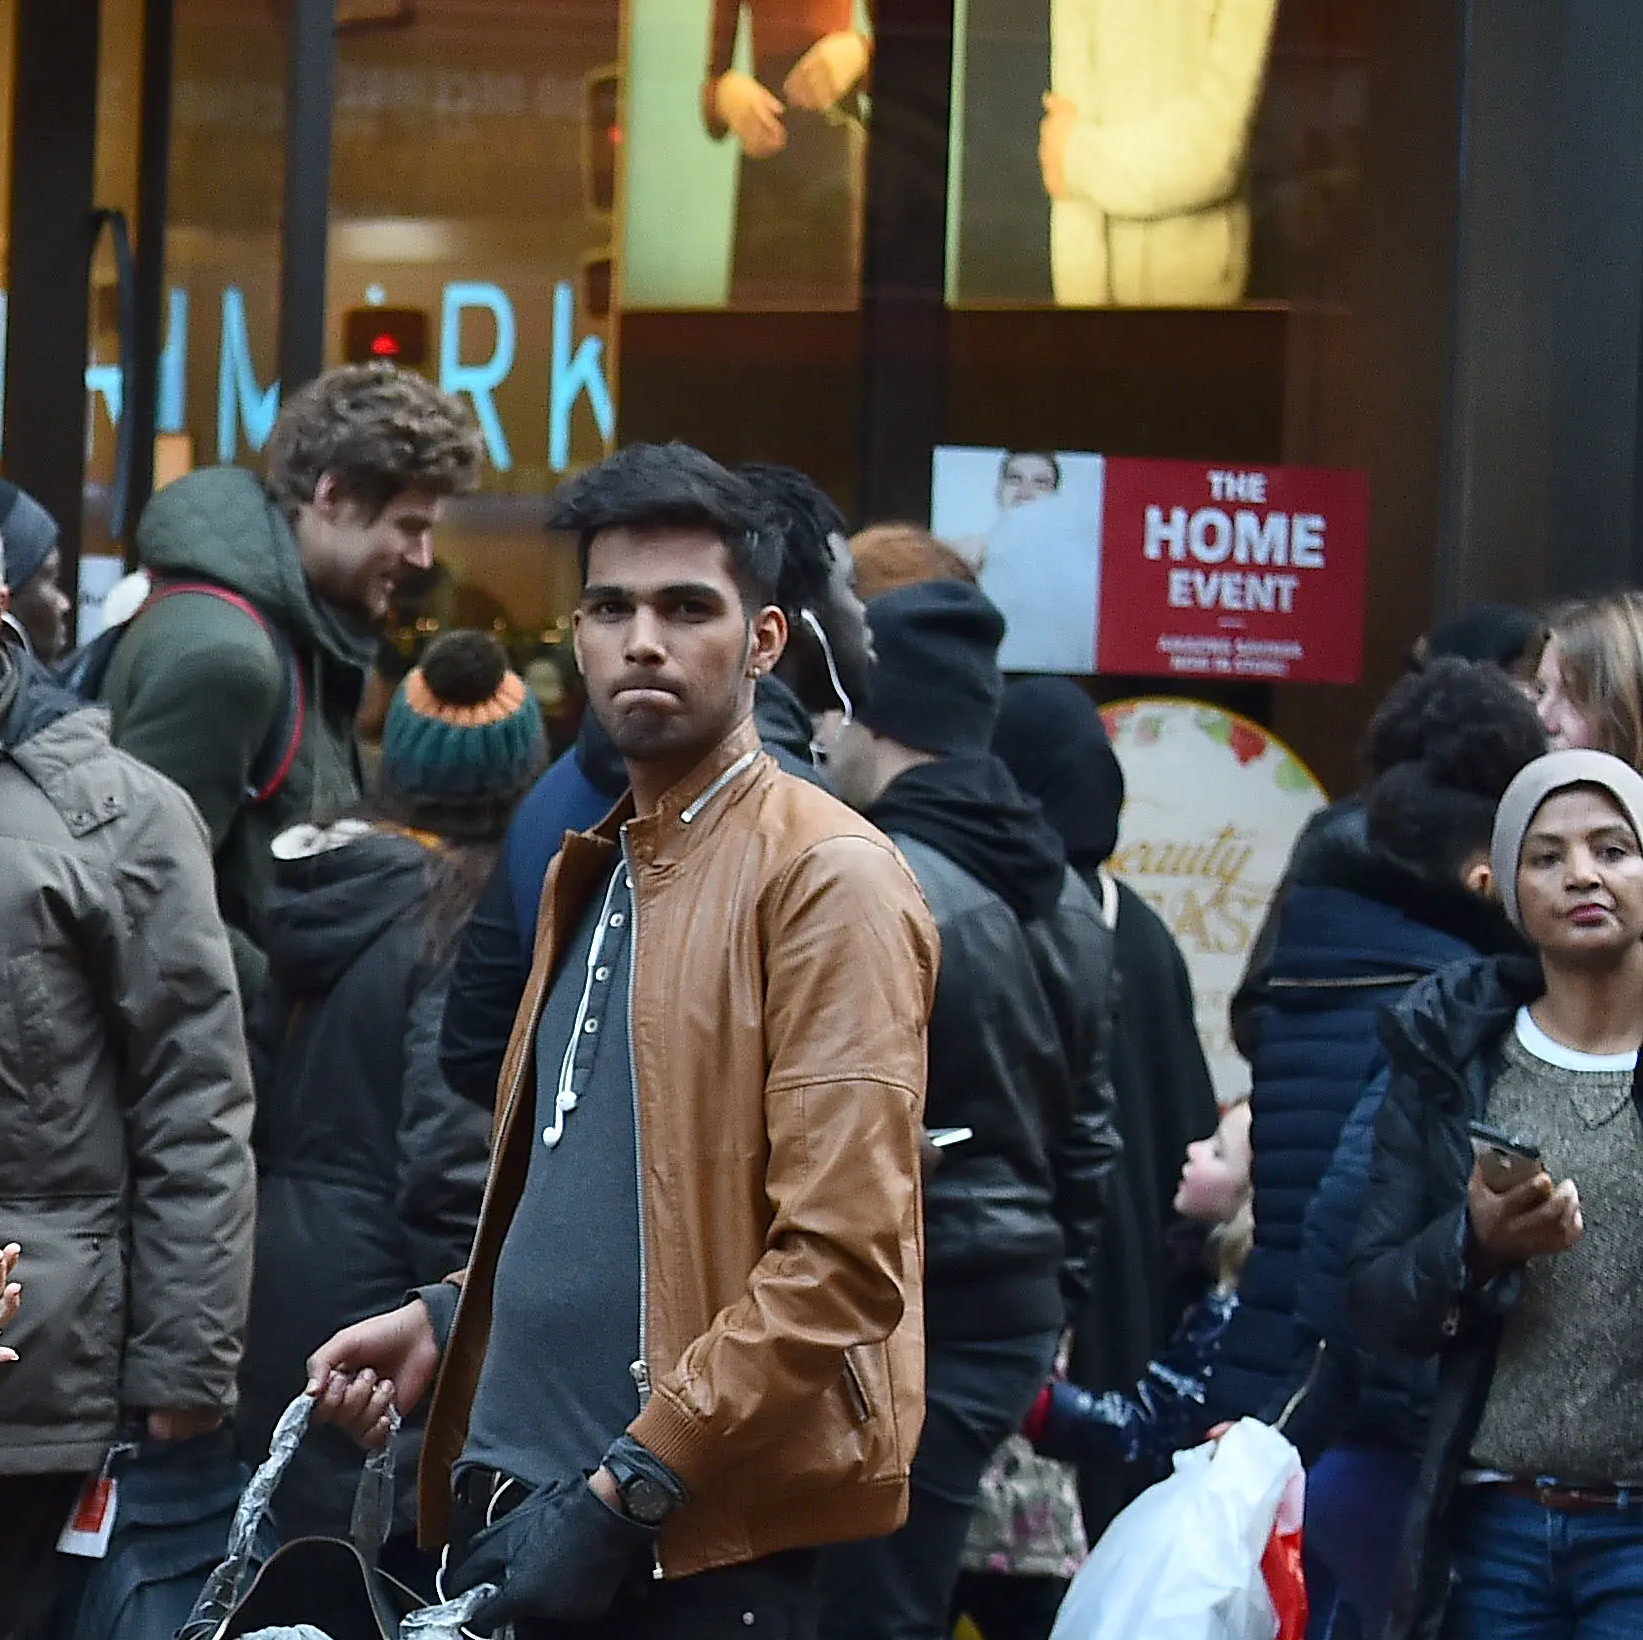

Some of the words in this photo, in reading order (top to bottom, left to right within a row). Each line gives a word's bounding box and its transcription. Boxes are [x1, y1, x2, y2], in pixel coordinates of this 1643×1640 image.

[1208, 470, 1268, 503] THE
[1143, 504, 1327, 568] HOME
[1168, 568, 1300, 612] EVENT
[1106, 825, 1253, 890] eauty
